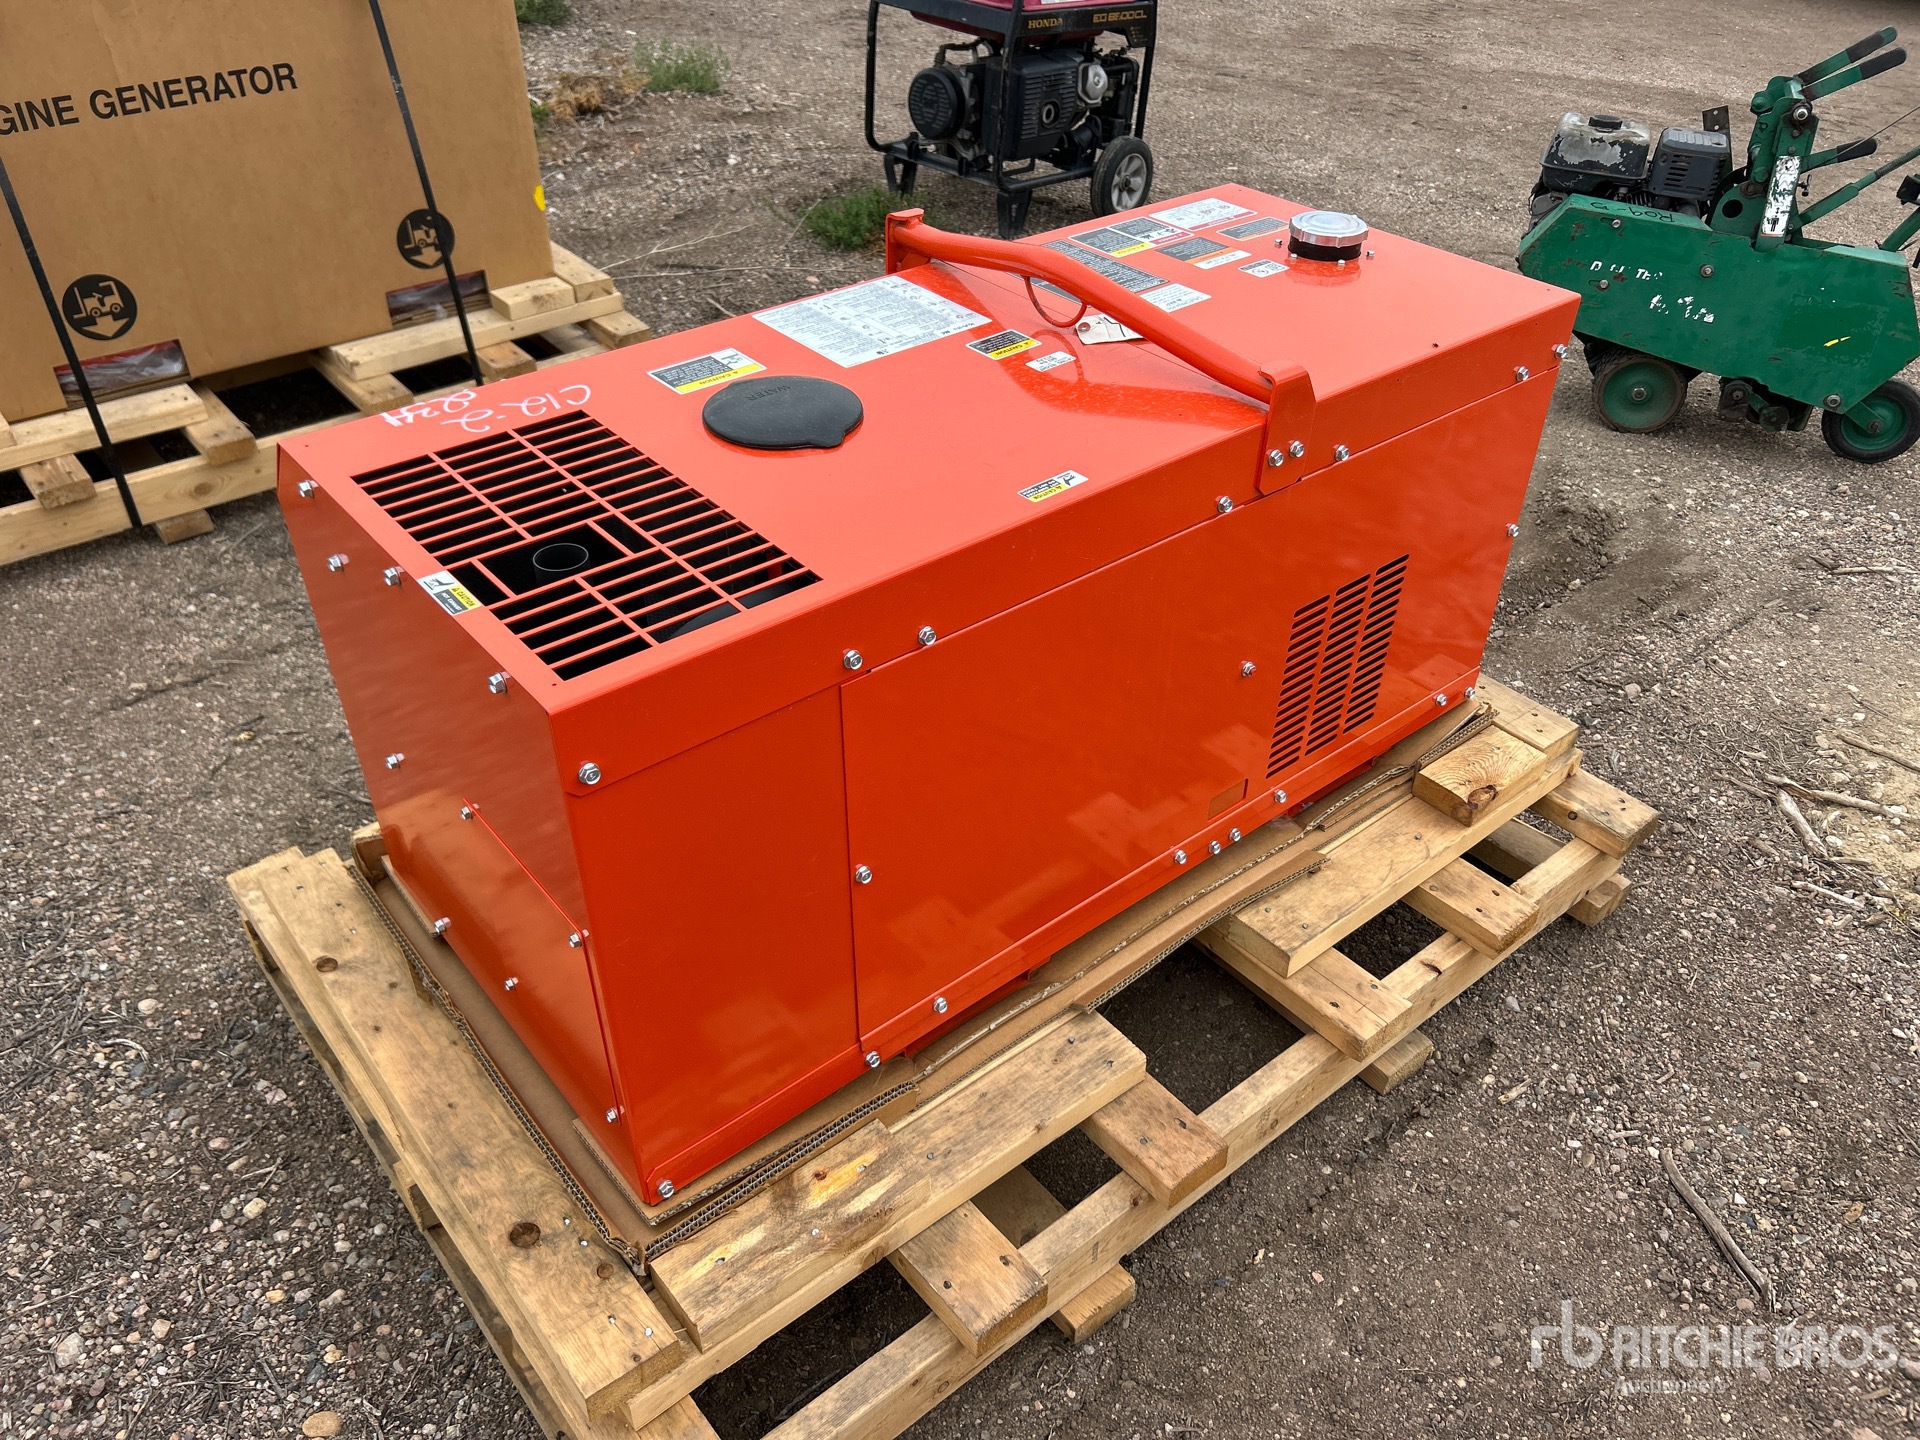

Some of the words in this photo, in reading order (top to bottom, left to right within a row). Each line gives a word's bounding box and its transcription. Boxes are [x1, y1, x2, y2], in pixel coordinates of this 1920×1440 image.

[1028, 17, 1063, 29] HONDA
[90, 62, 299, 120] GENERATOR
[744, 384, 793, 402] WATER
